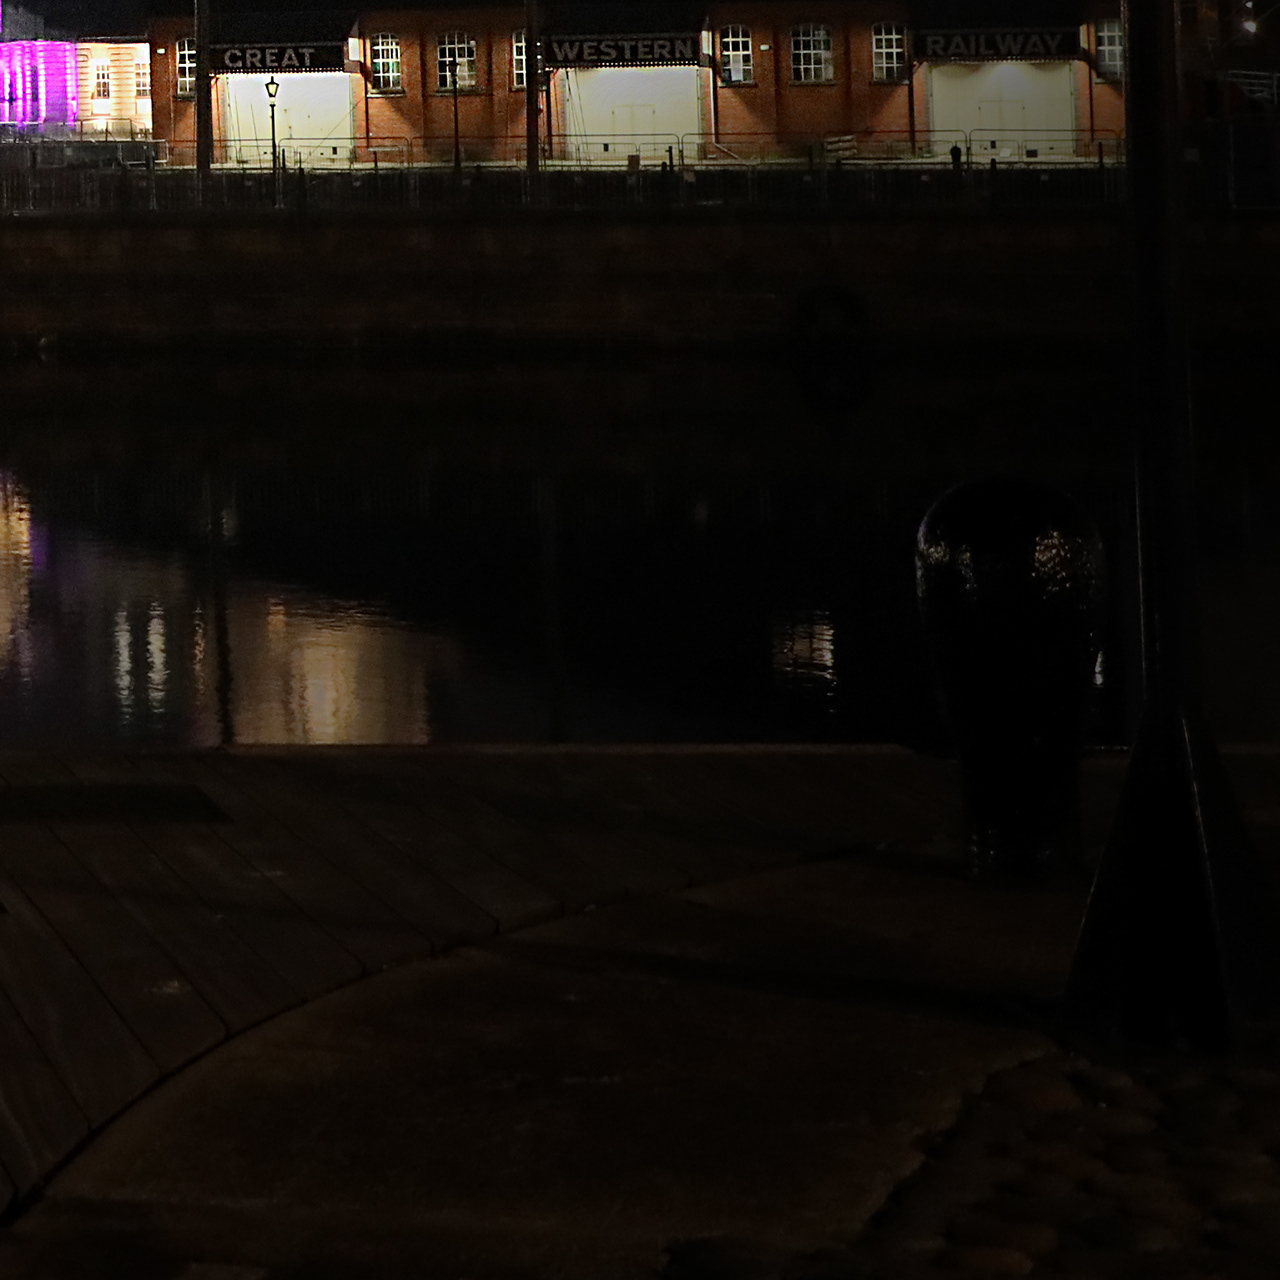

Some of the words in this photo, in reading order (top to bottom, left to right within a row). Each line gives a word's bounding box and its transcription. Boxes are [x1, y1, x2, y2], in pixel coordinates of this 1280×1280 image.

[553, 39, 696, 61] WESTERN
[925, 33, 1063, 56] RAILWAY
[224, 48, 316, 68] GREAT
